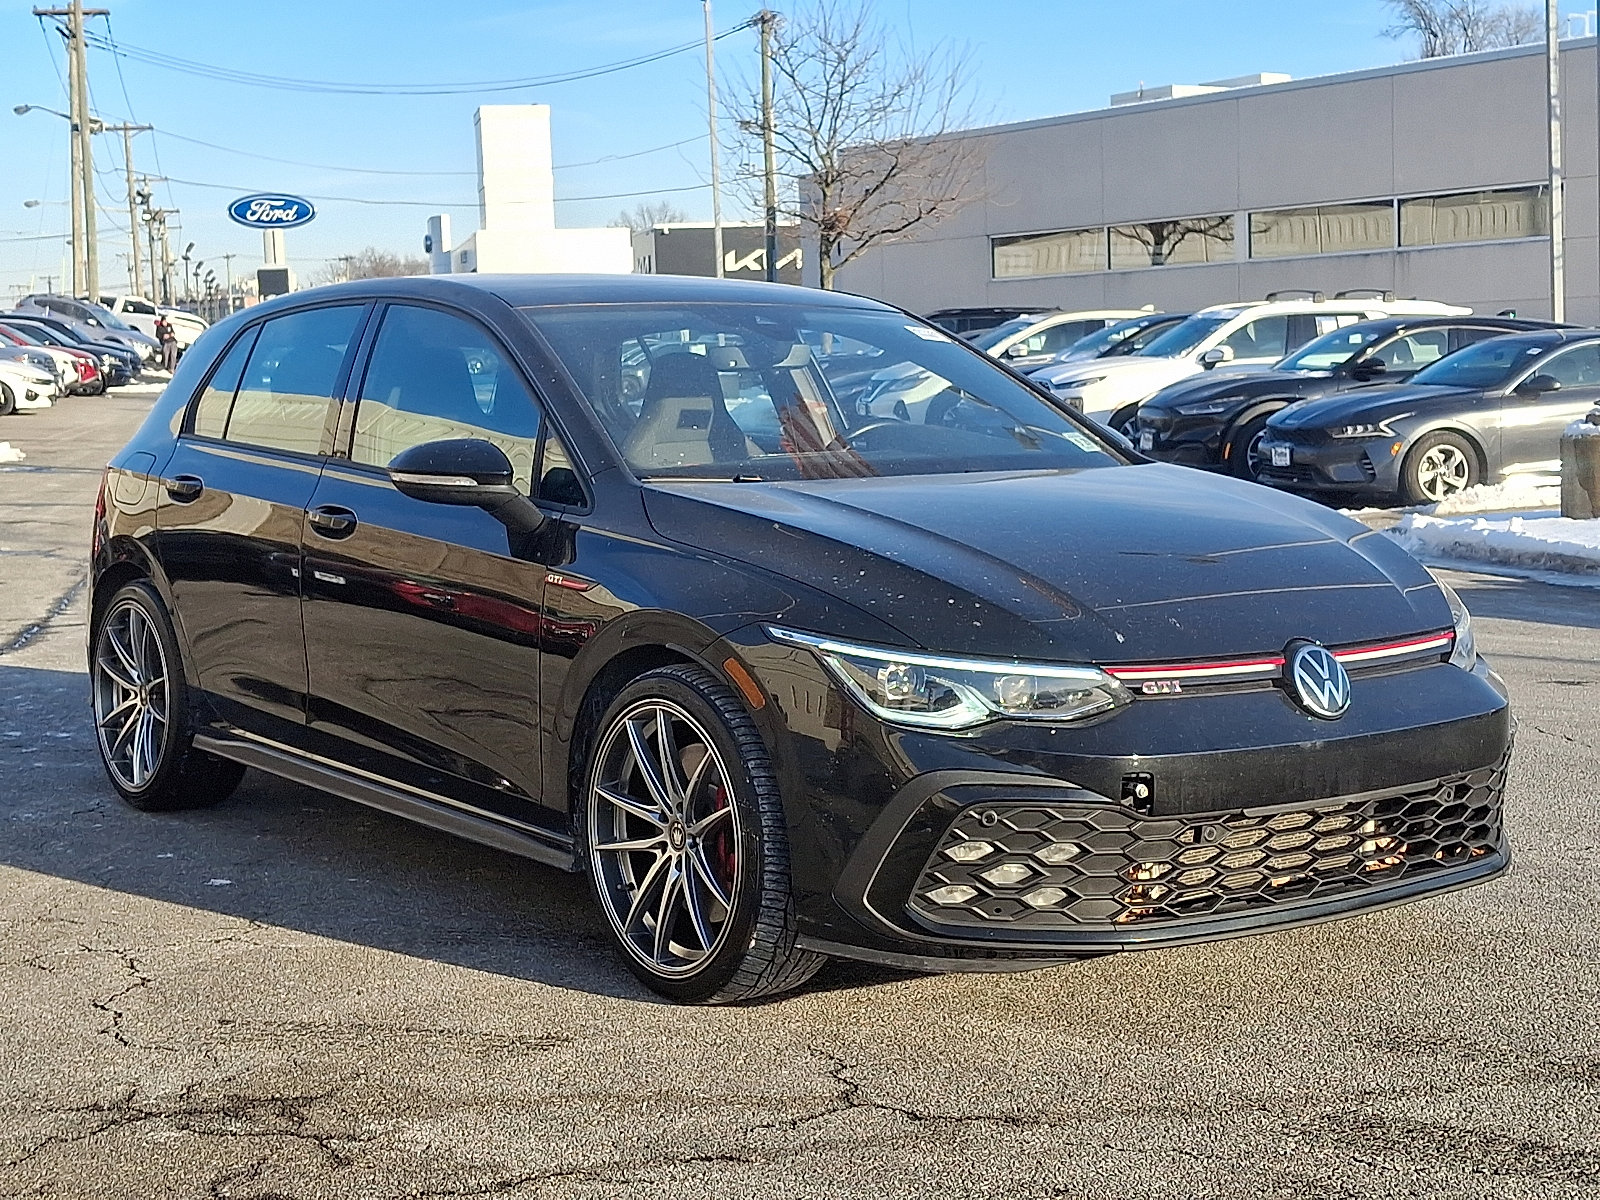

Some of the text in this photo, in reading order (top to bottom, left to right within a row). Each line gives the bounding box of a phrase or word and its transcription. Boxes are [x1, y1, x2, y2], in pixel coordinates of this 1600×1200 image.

[246, 199, 299, 222] Ford
[547, 574, 563, 585] GTI
[1142, 680, 1182, 695] GTI
[1296, 648, 1347, 712] VW
